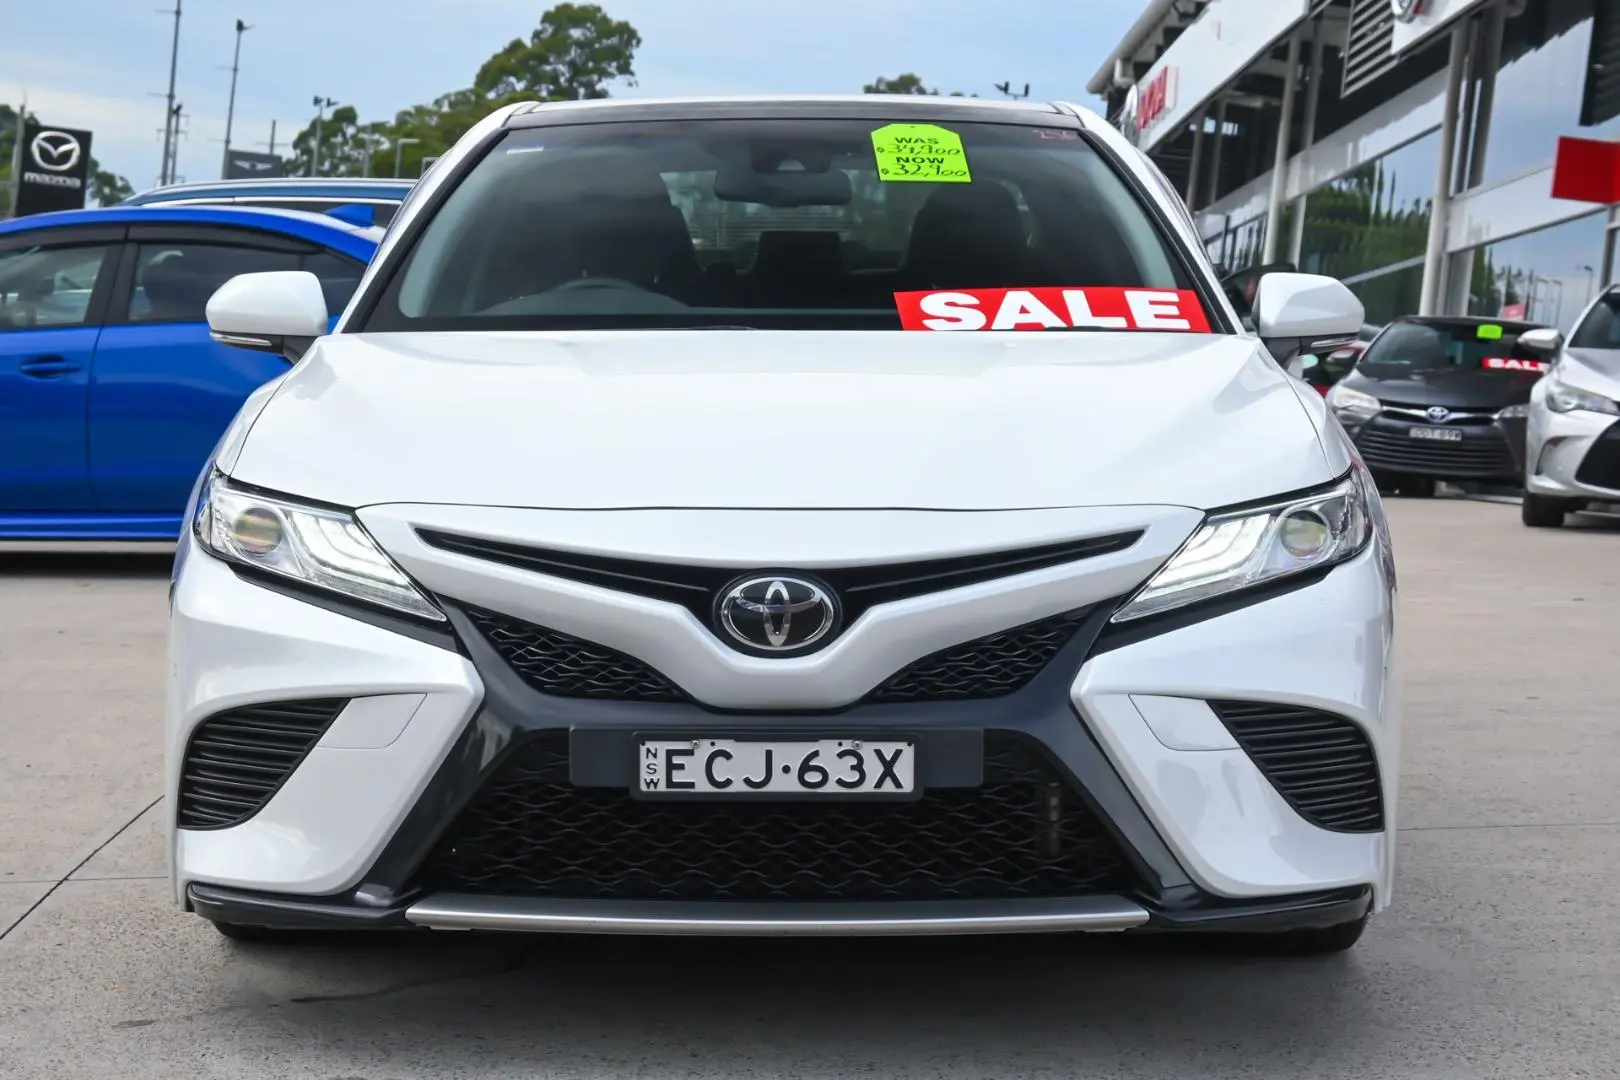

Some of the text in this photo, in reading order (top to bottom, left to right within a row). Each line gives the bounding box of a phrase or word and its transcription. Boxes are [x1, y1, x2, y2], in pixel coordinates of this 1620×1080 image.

[895, 156, 945, 164] NOW
[919, 290, 1192, 331] SALE
[644, 747, 660, 790] NSW
